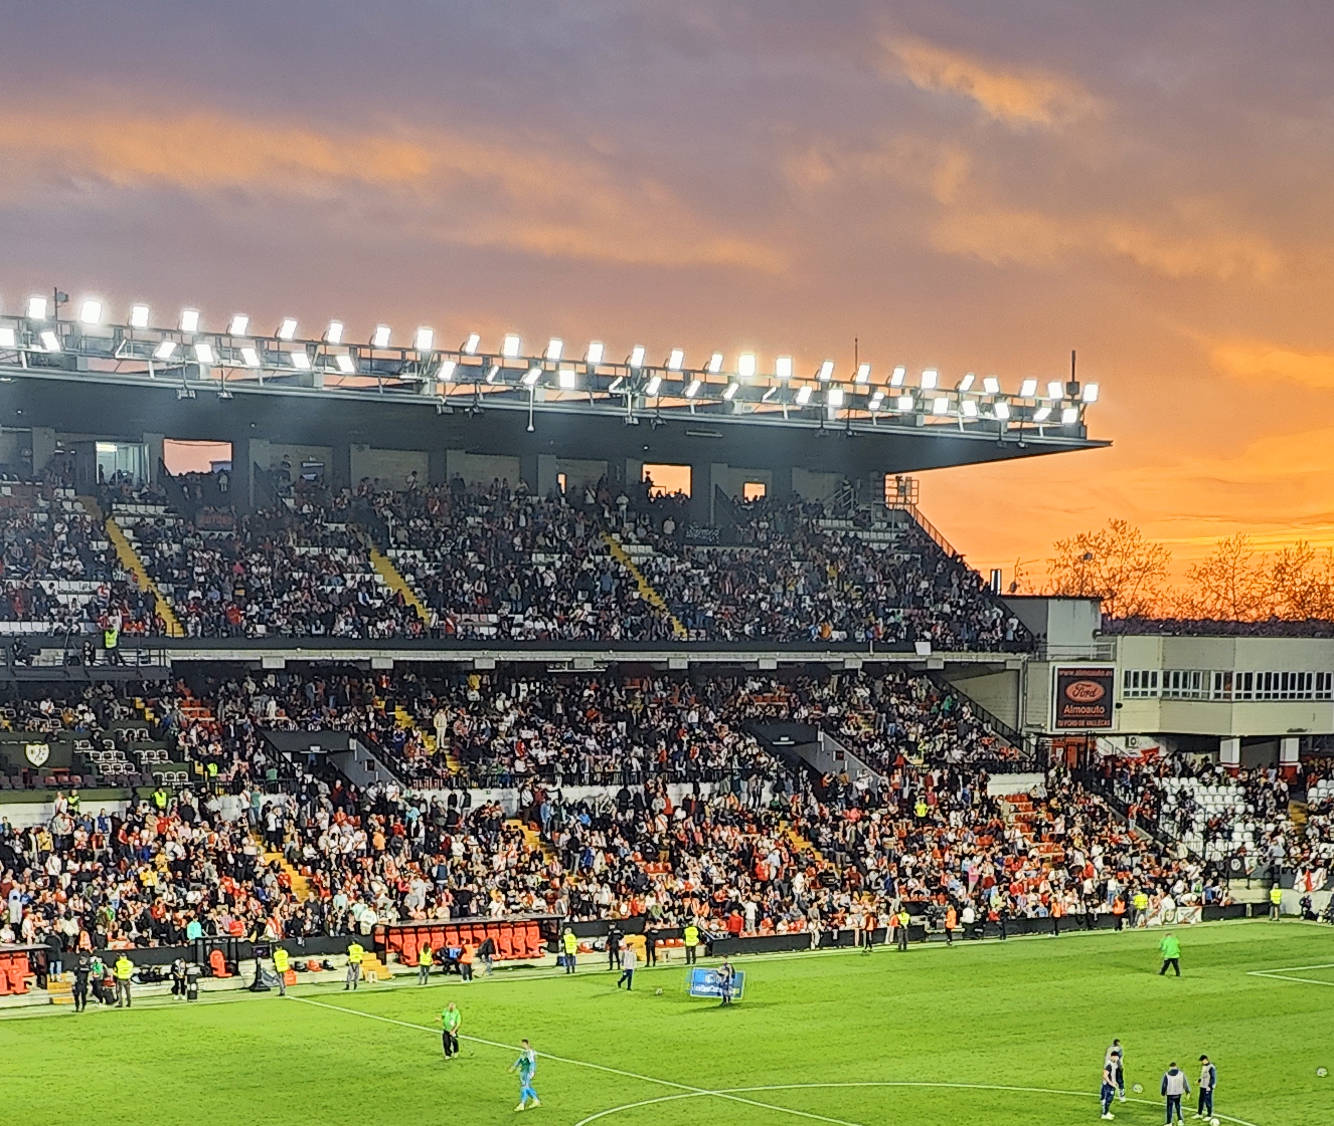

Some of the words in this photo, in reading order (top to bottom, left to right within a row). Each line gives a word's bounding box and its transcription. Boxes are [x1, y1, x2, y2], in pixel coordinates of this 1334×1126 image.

[1072, 683, 1098, 698] Ford
[1063, 704, 1105, 714] Almoauto
[1064, 719, 1078, 727] FORD
